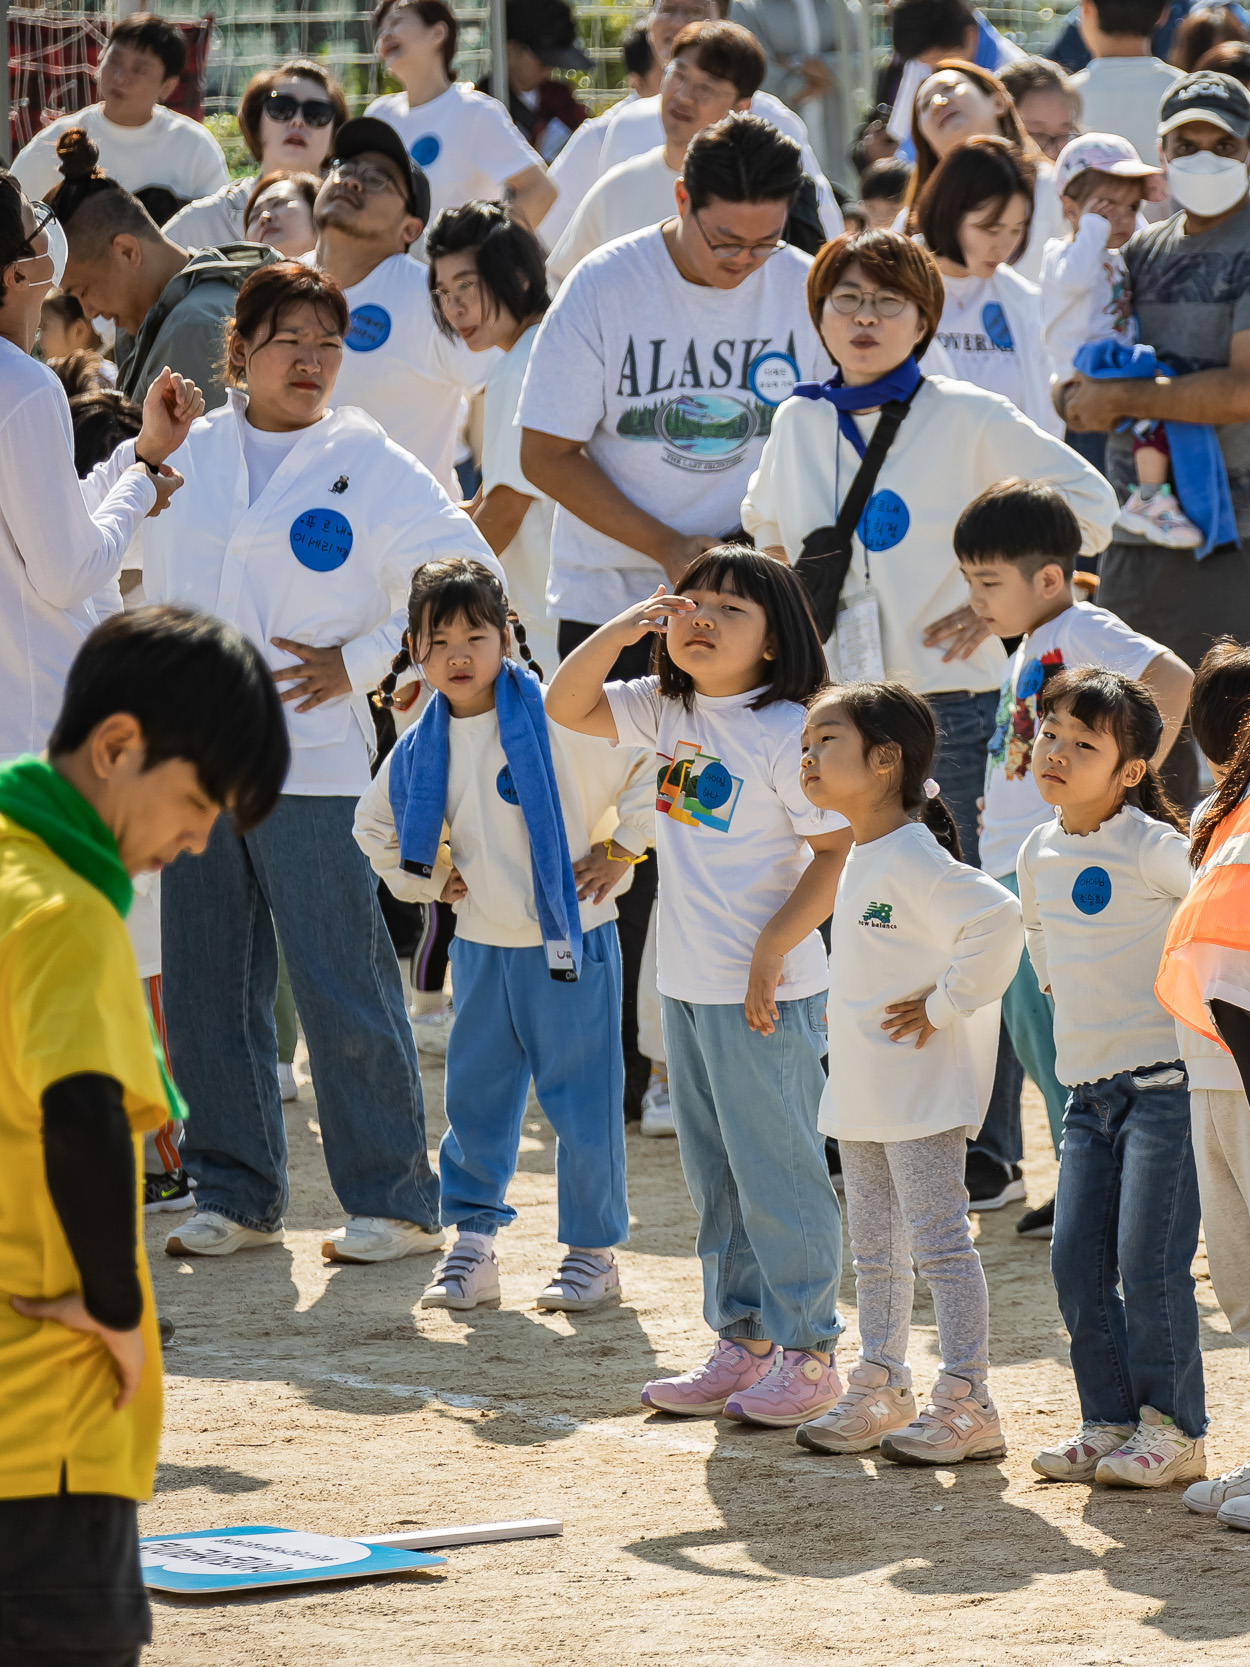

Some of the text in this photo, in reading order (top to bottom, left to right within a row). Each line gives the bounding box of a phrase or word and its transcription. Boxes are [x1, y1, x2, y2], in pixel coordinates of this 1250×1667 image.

[1178, 83, 1230, 101] LOCAL
[702, 787, 720, 801] 하나
[1079, 893, 1104, 907] 조승희
[871, 920, 898, 929] balance
